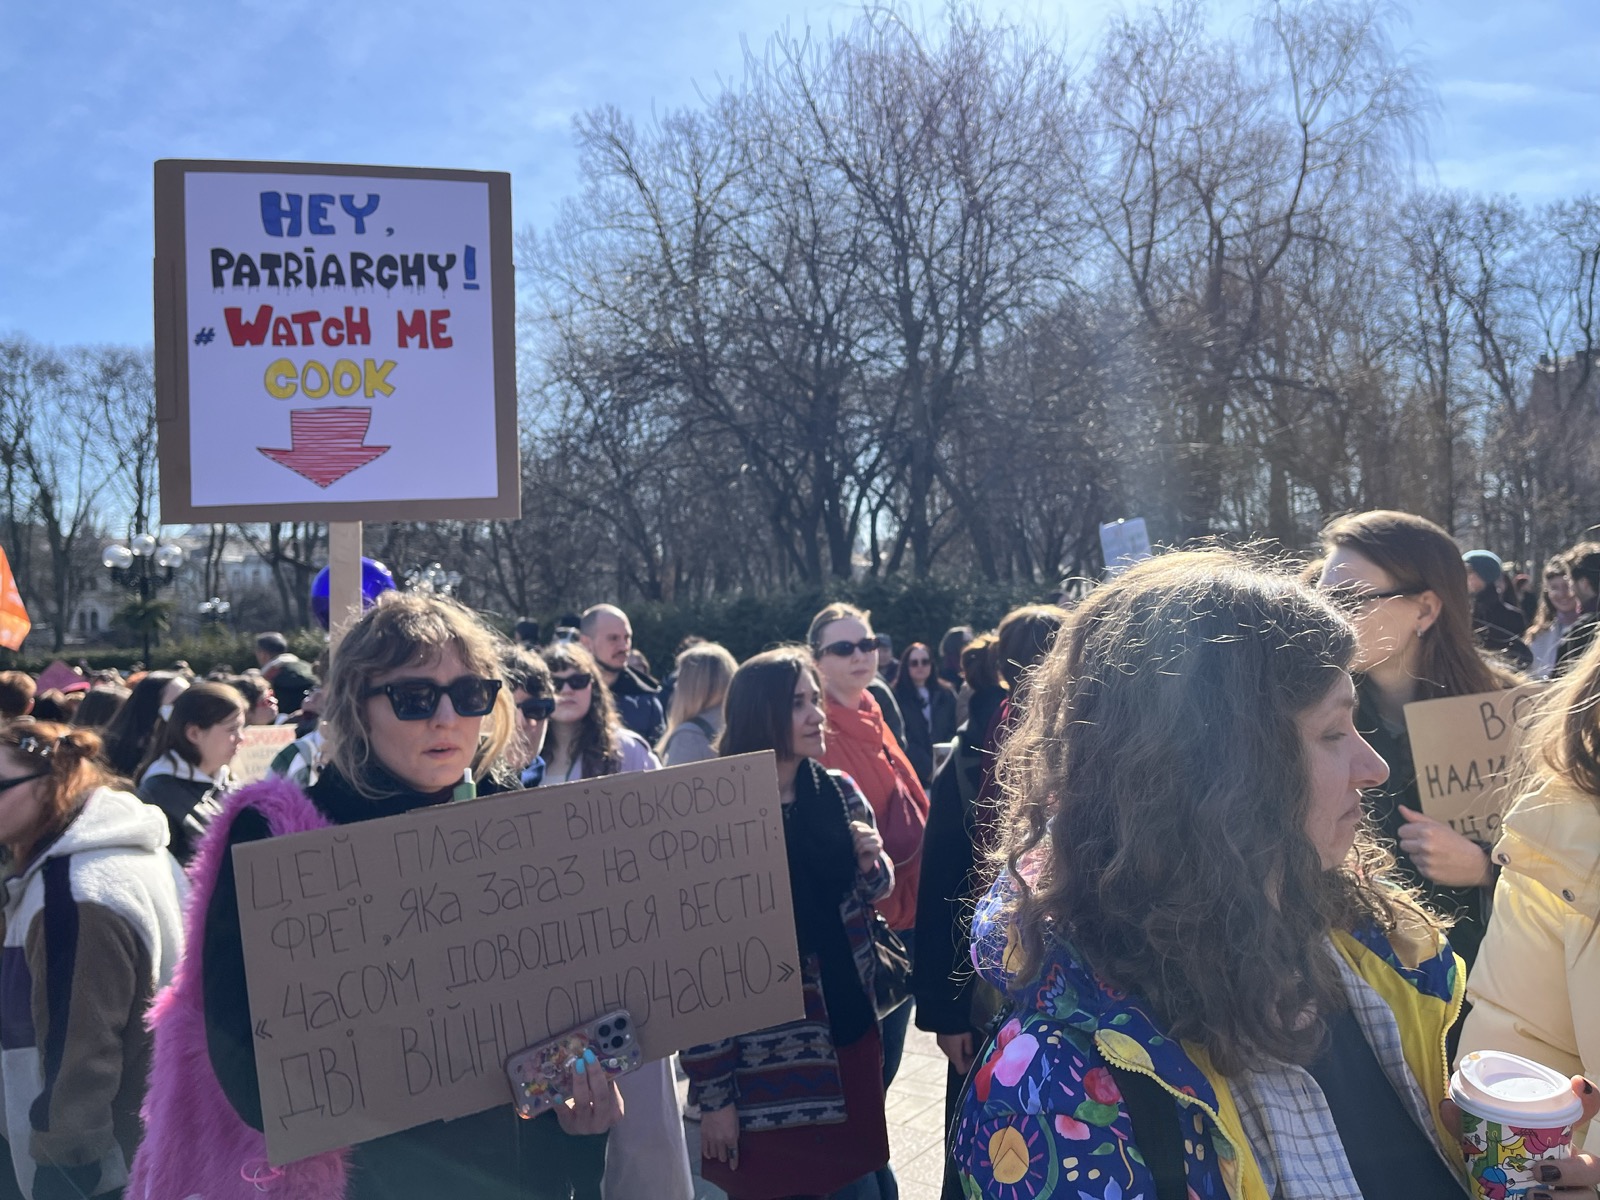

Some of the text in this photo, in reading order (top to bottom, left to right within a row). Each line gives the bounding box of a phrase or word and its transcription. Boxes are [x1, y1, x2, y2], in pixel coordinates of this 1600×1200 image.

[260, 190, 395, 237] HEY,
[397, 309, 453, 349] ME
[264, 358, 398, 399] COOK
[250, 834, 361, 911] ЦЕЙ
[564, 764, 750, 841] ВІЙСЬКОВОЇ
[446, 894, 661, 992] ДОВОДИТЬСЯ
[679, 871, 776, 932] ВЕСТИ
[279, 1028, 366, 1131] ДВІ
